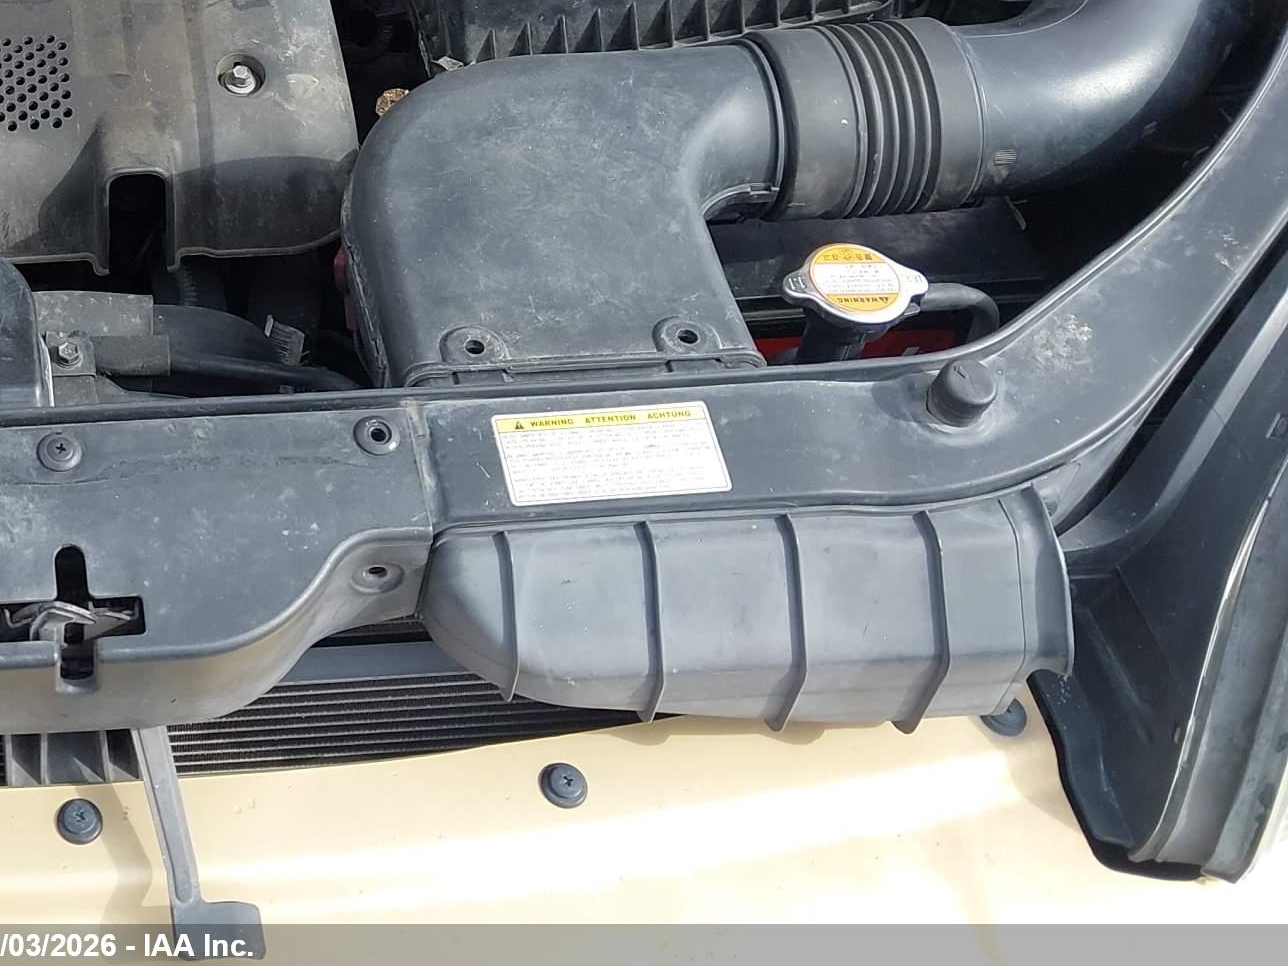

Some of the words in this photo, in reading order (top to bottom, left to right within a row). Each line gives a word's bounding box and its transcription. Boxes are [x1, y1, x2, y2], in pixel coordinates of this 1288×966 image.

[529, 418, 575, 428] WARNING
[584, 414, 637, 425] ATTENTION
[647, 409, 692, 420] ACHTUNG
